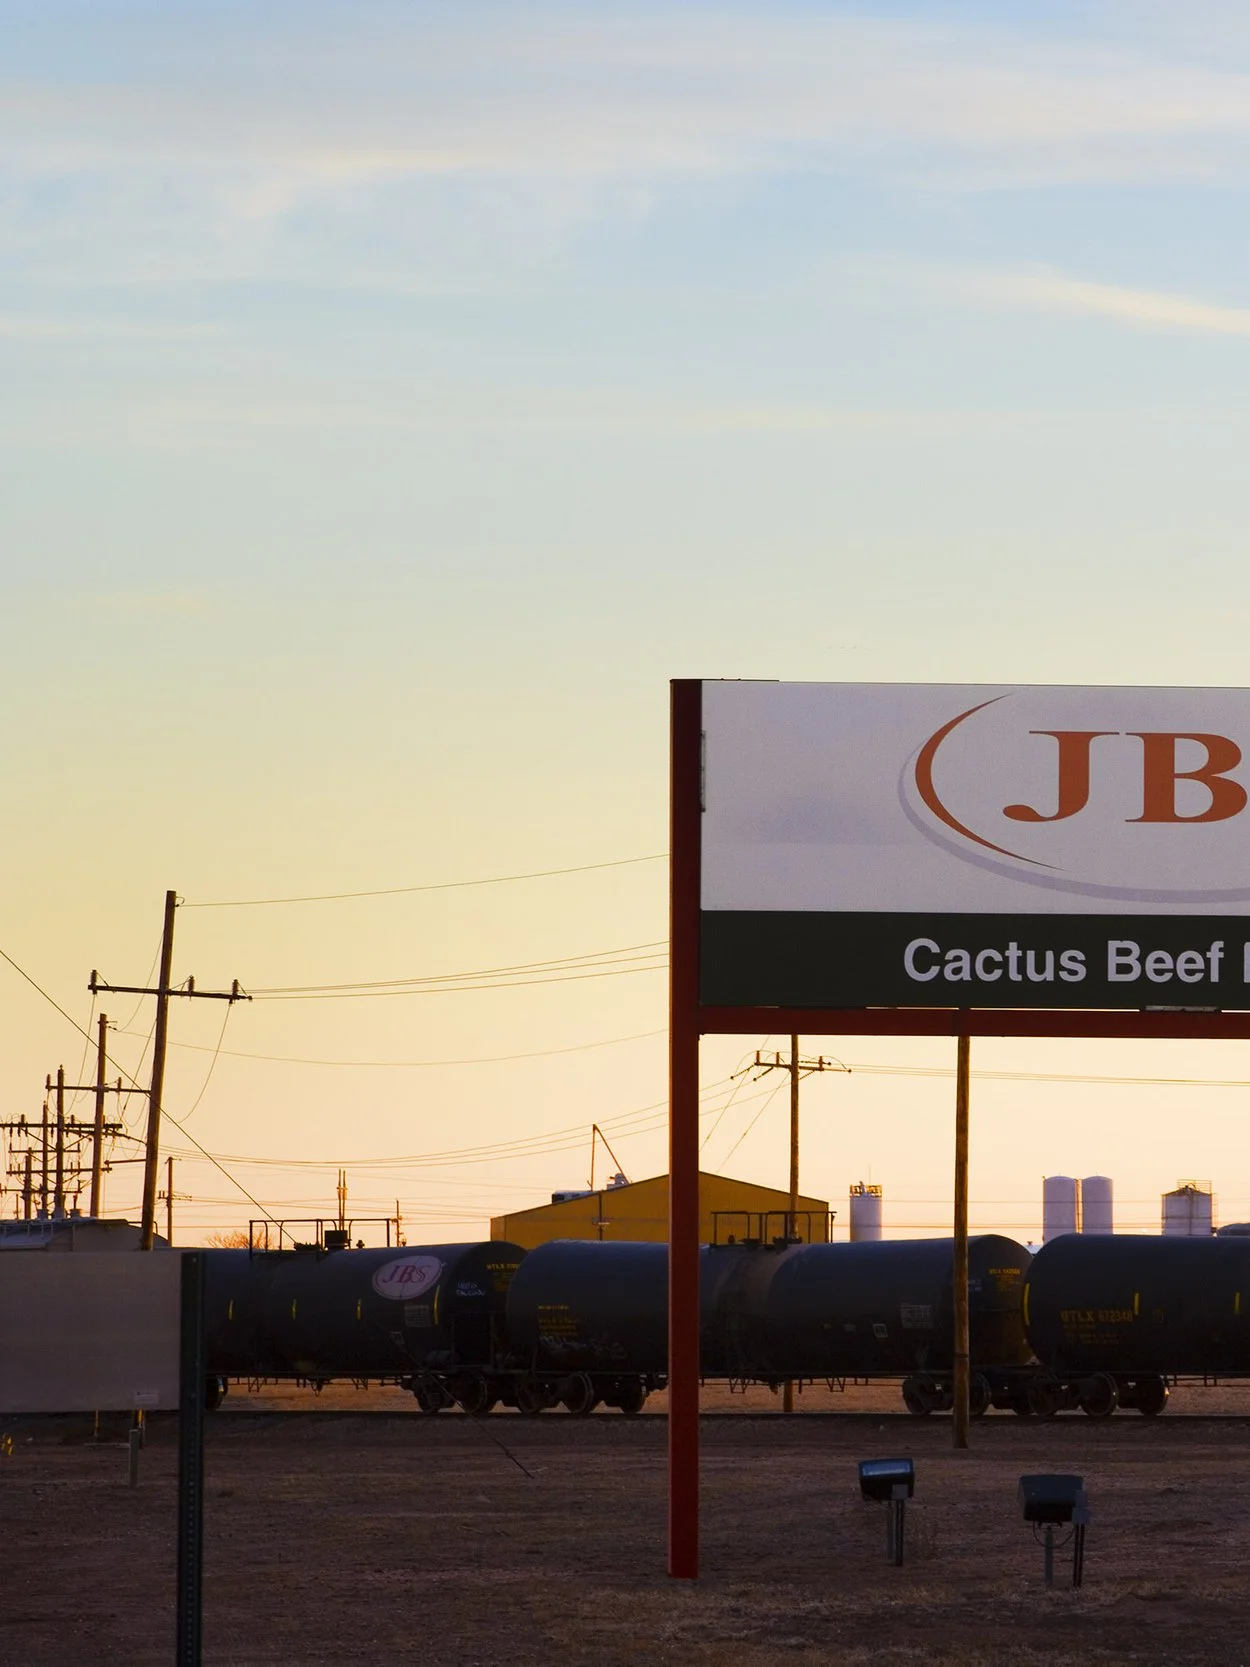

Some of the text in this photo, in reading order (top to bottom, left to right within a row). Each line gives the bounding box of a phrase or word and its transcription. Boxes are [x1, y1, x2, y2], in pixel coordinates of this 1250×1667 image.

[903, 937, 1088, 983] Cactus
[1106, 940, 1225, 983] Beef
[382, 1264, 431, 1284] JBS
